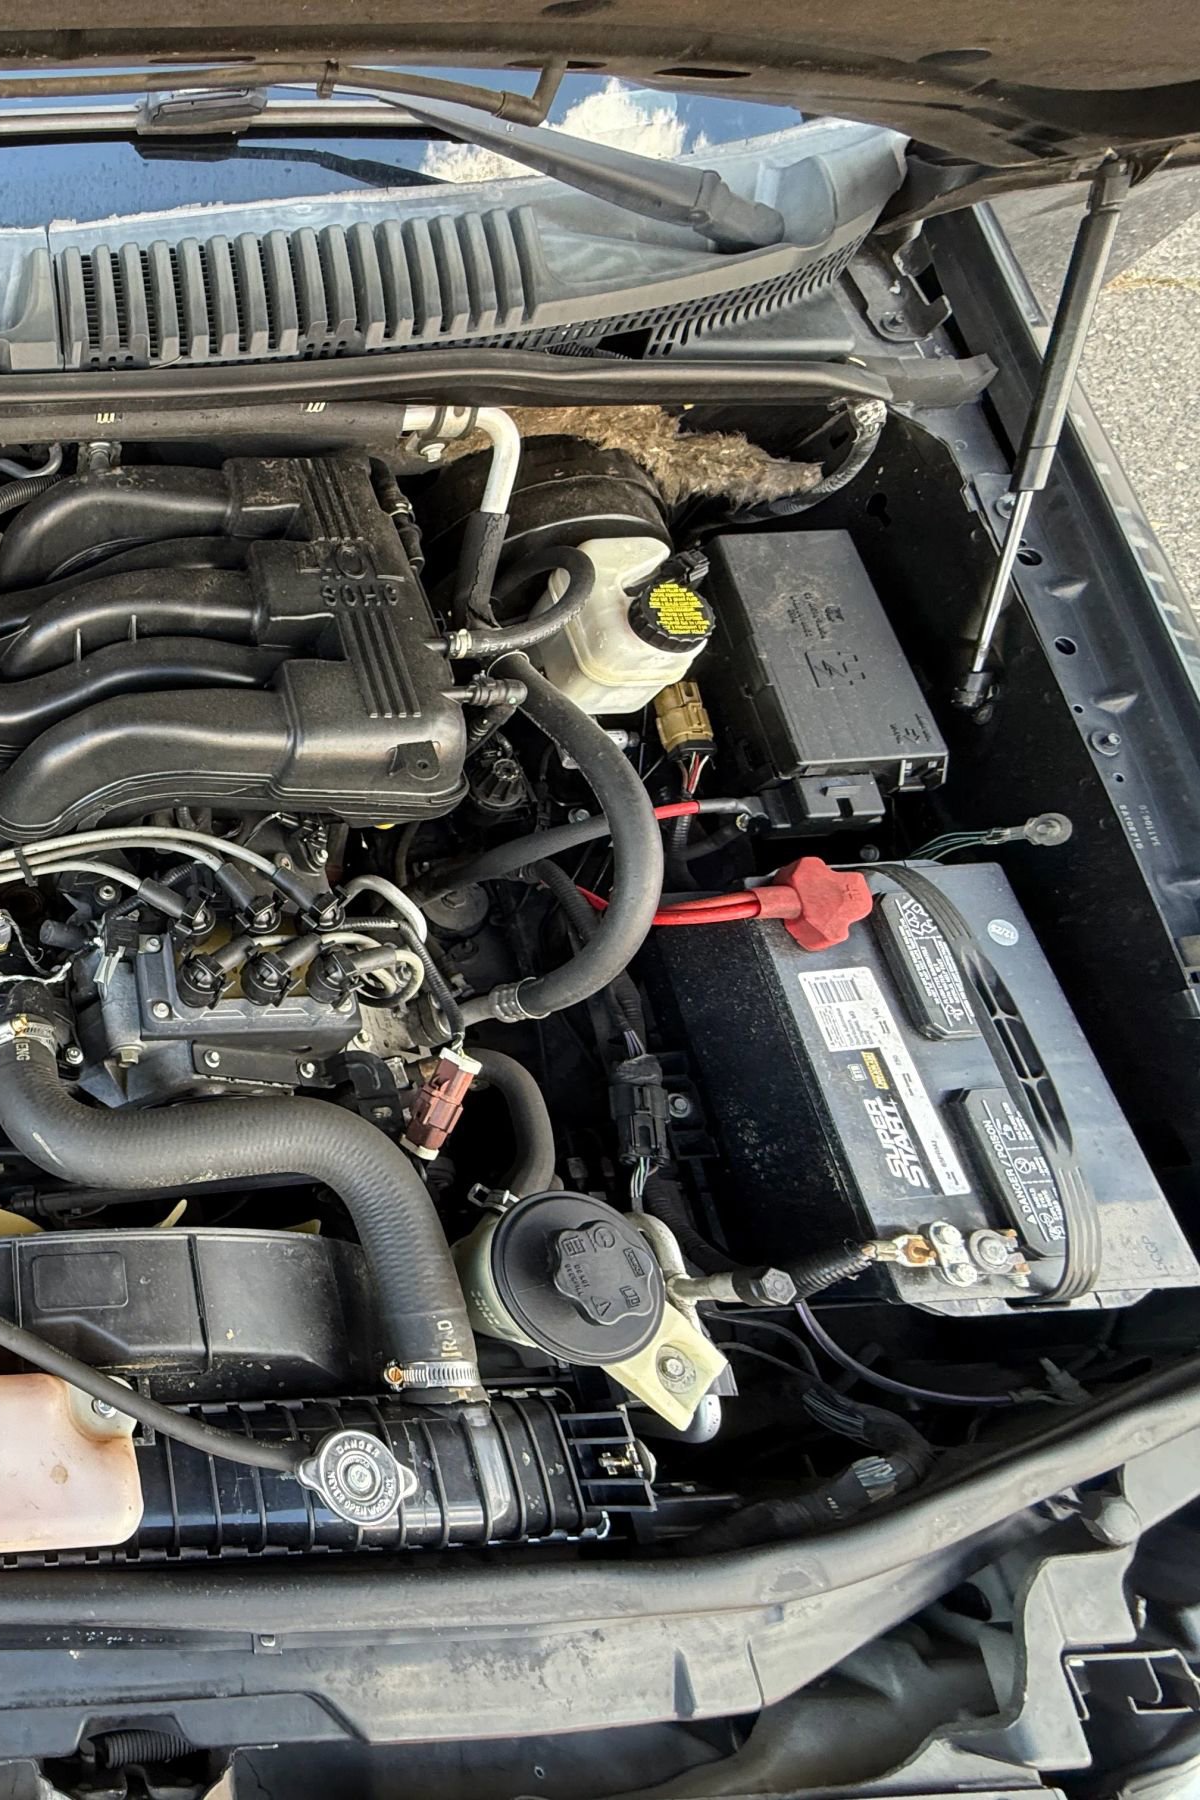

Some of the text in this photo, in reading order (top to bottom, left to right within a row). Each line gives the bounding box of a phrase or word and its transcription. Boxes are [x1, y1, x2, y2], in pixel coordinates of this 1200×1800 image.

[322, 584, 400, 607] SOHC
[15, 1042, 30, 1060] ENG
[863, 1098, 906, 1178] SUPER
[875, 1096, 931, 1189] START
[982, 1119, 1007, 1160] POISON
[1005, 1167, 1032, 1214] DANGER
[335, 1440, 381, 1458] DANGER
[327, 1470, 346, 1504] NEVER
[344, 1499, 368, 1516] OPEN
